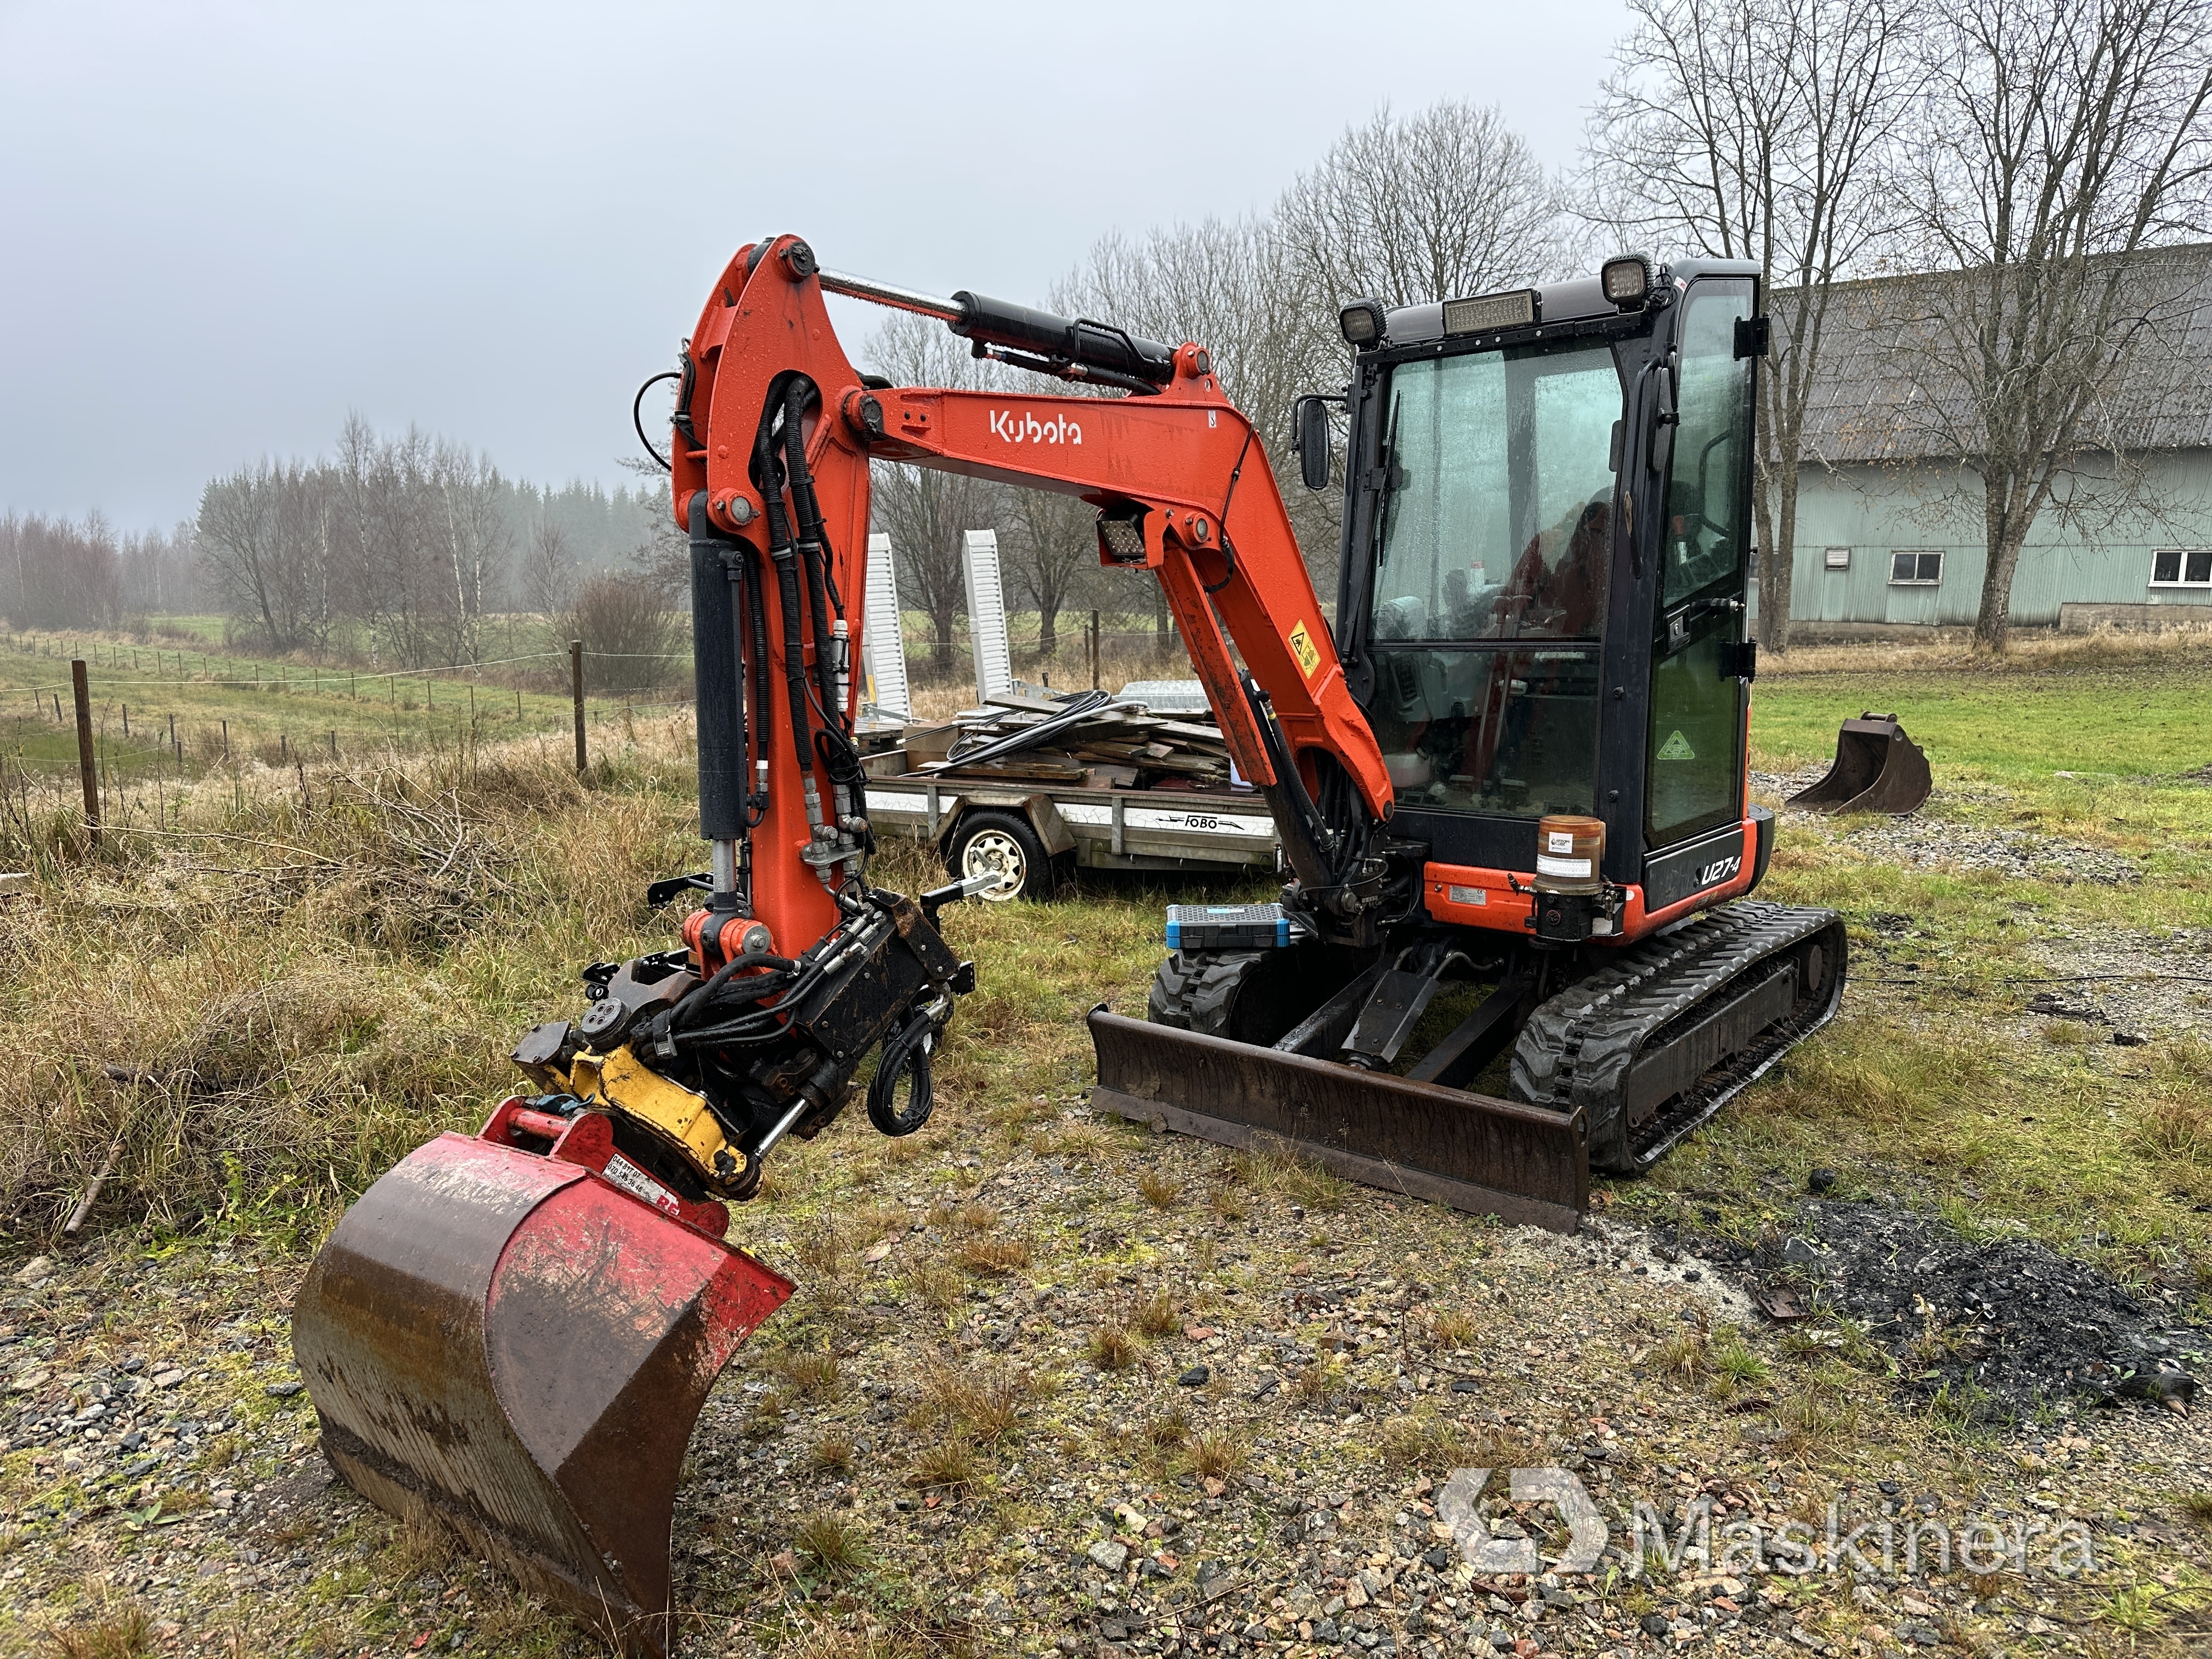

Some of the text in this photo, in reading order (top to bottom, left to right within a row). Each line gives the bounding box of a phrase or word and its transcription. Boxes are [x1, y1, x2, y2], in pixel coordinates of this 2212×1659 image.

[990, 410, 1082, 444] Kubota
[1185, 815, 1218, 829] FOBO
[1701, 856, 1741, 885] U27-4
[612, 1155, 623, 1166] 044
[607, 1164, 618, 1174] 070
